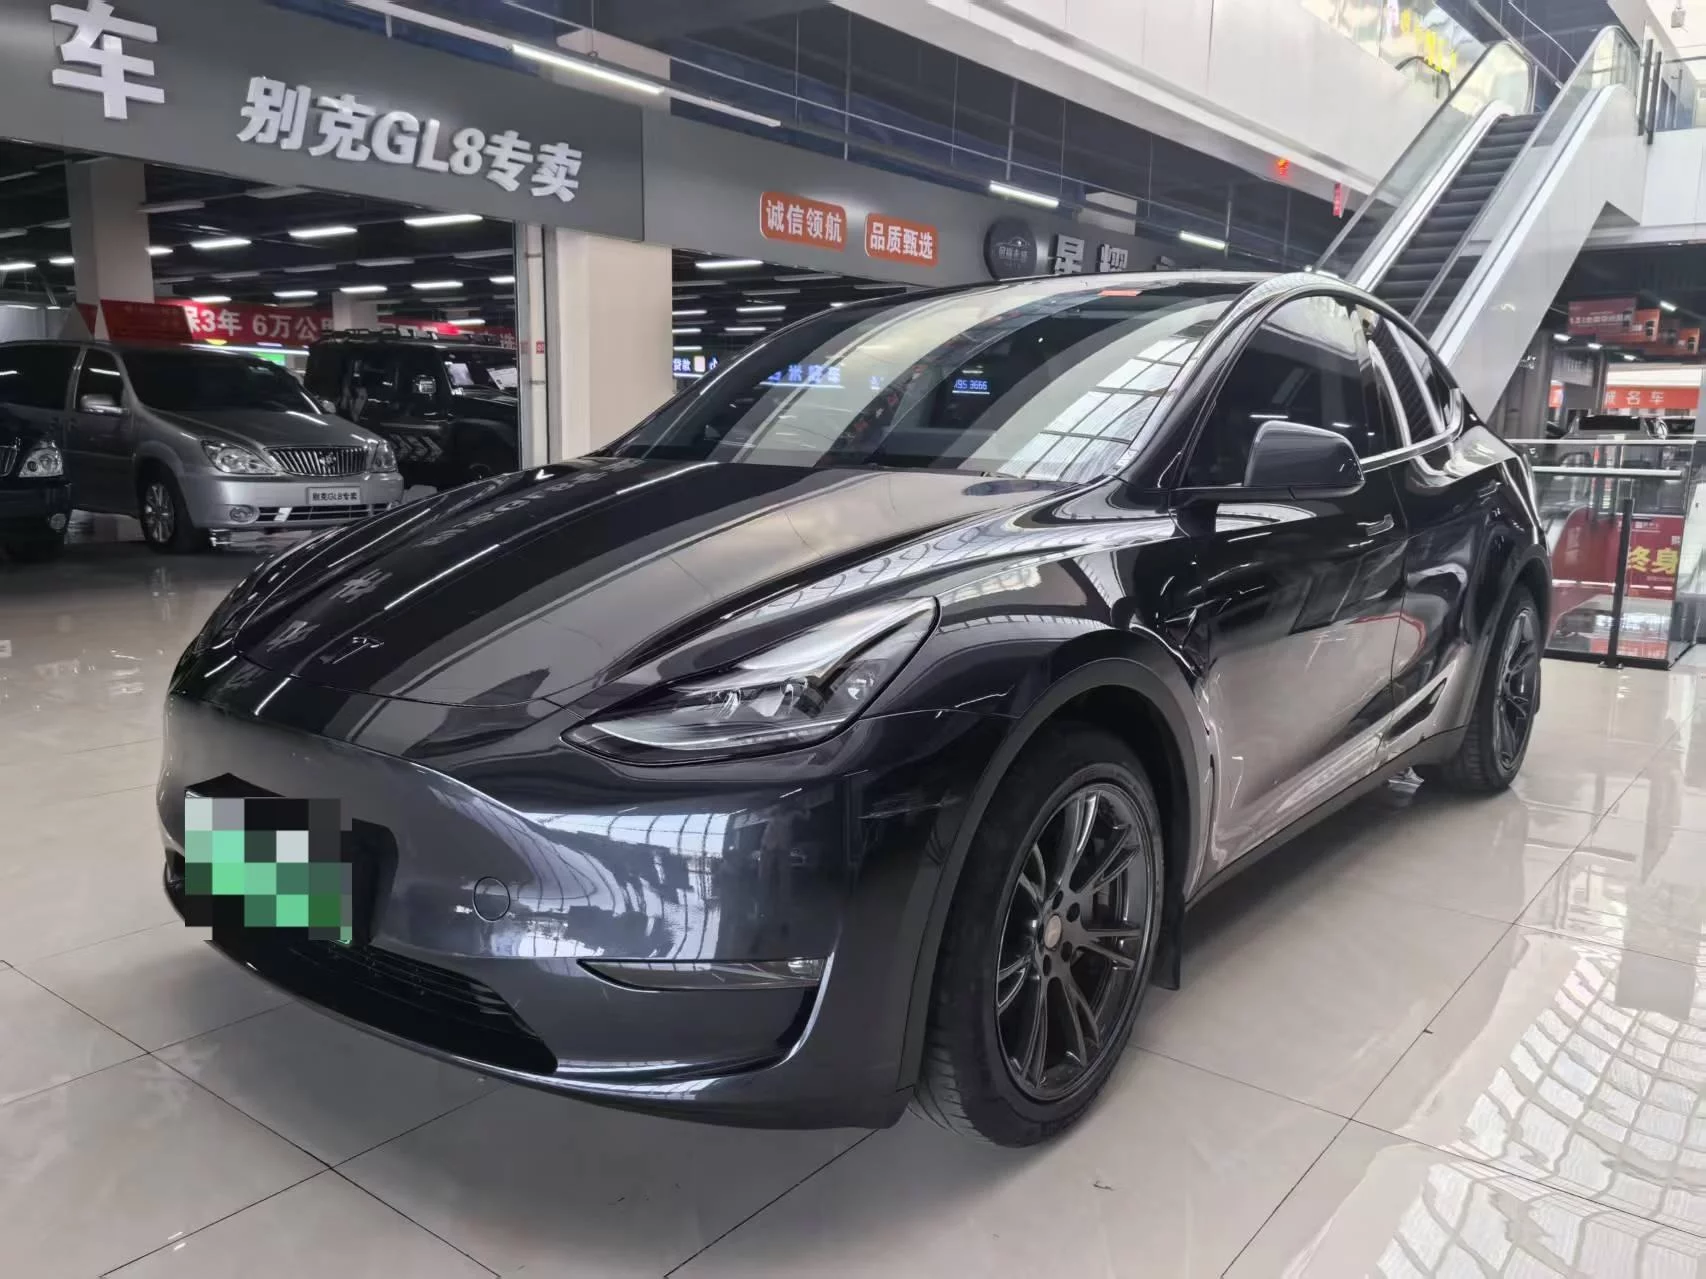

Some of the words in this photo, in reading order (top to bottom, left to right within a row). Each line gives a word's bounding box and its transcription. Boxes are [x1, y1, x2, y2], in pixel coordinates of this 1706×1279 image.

[51, 0, 165, 120] 车
[236, 75, 583, 202] 别克GL8专卖
[766, 200, 842, 243] 诚信领航
[870, 222, 933, 260] 品质甄选
